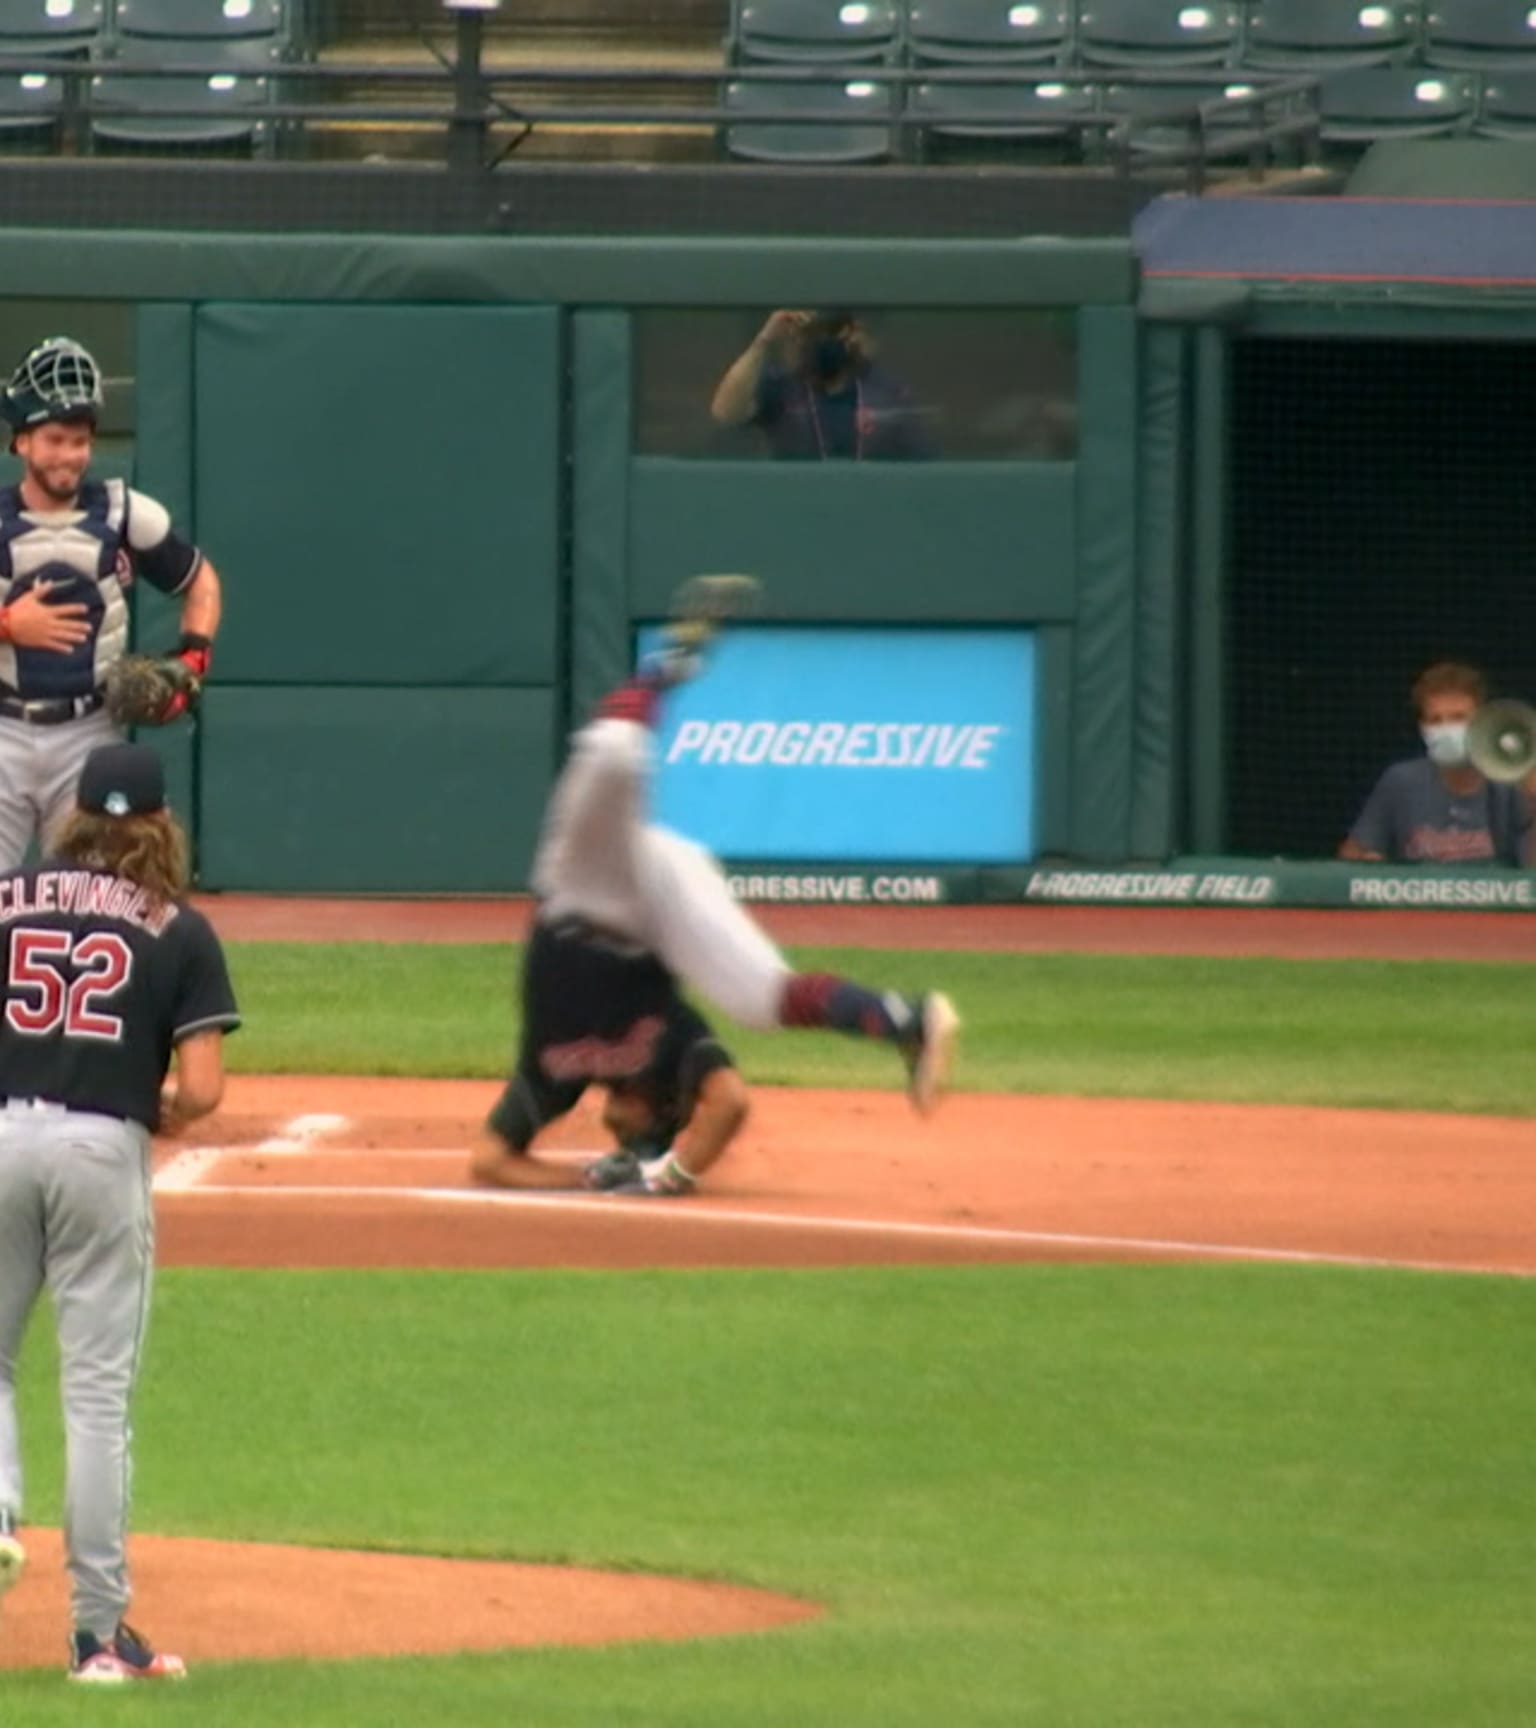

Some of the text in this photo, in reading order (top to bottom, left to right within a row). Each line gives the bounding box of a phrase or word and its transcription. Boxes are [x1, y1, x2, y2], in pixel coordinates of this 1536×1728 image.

[666, 720, 1000, 768] PROGRESSIVE
[726, 875, 941, 900] GRESSIVE.COM
[1196, 874, 1272, 901] FIELD
[6, 928, 133, 1041] 52
